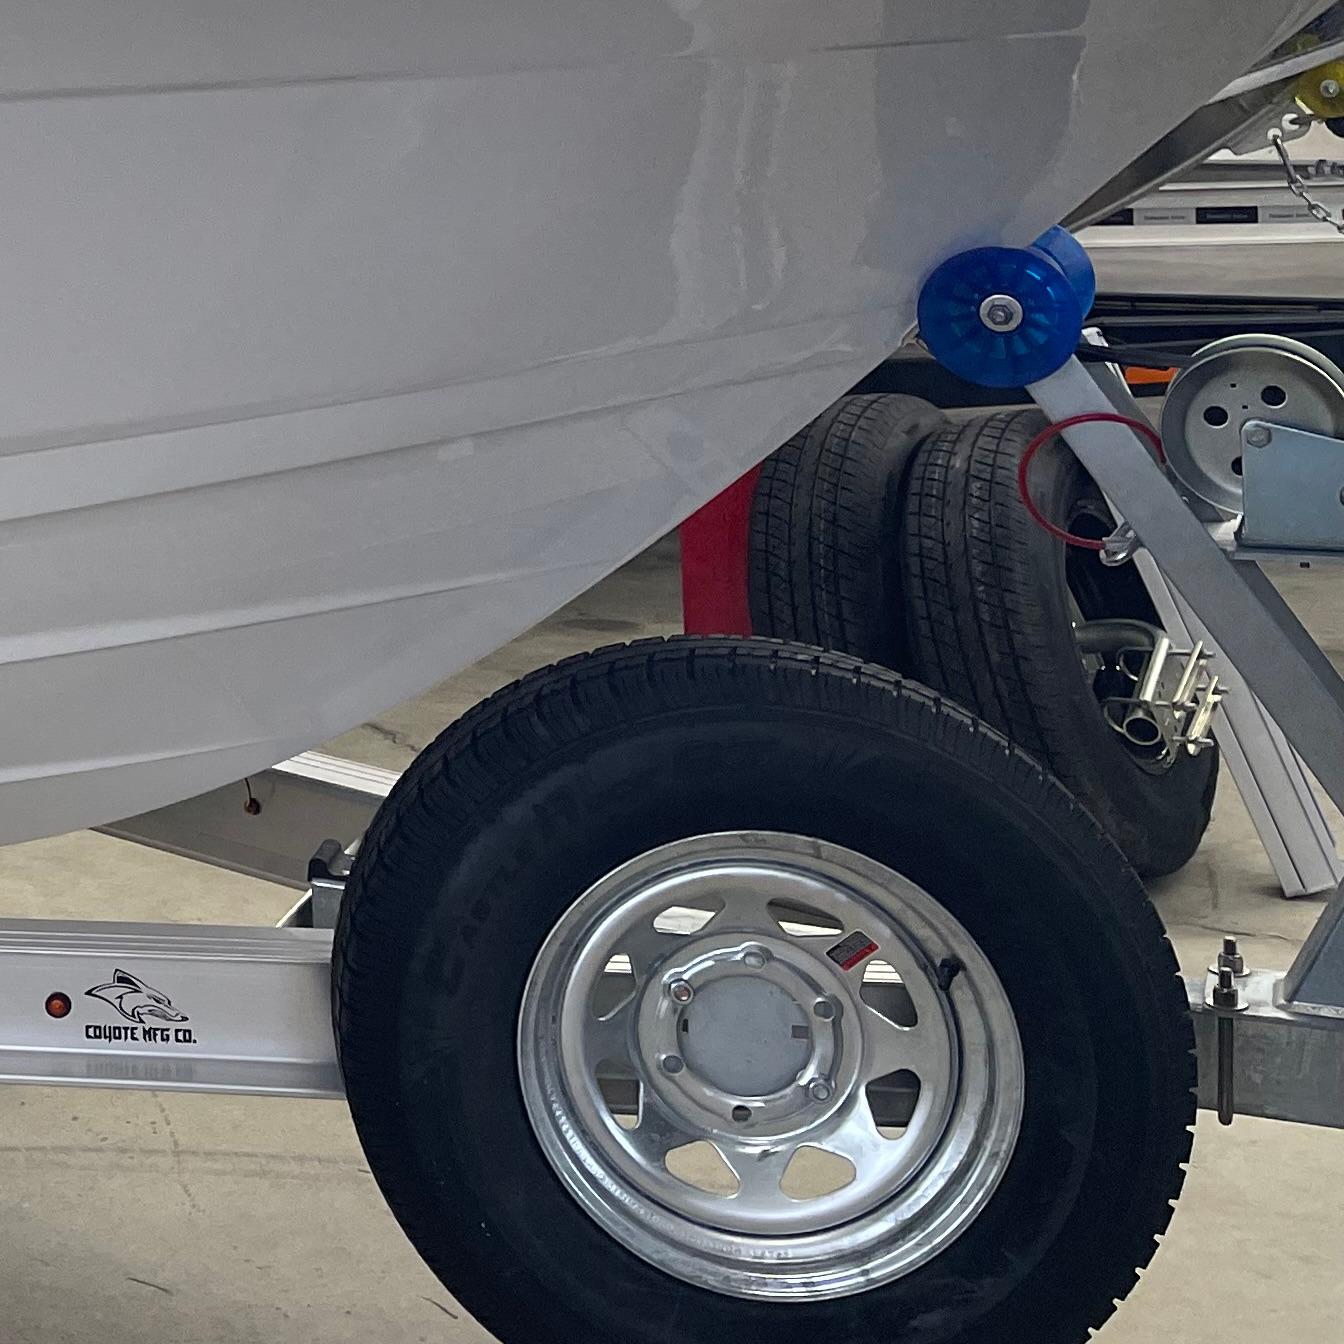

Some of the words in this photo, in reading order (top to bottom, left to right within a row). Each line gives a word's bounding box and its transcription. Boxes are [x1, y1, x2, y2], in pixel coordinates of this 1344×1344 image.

[85, 1024, 140, 1044] COYOTE
[142, 1026, 171, 1045] MFG
[174, 1028, 197, 1044] CO.
